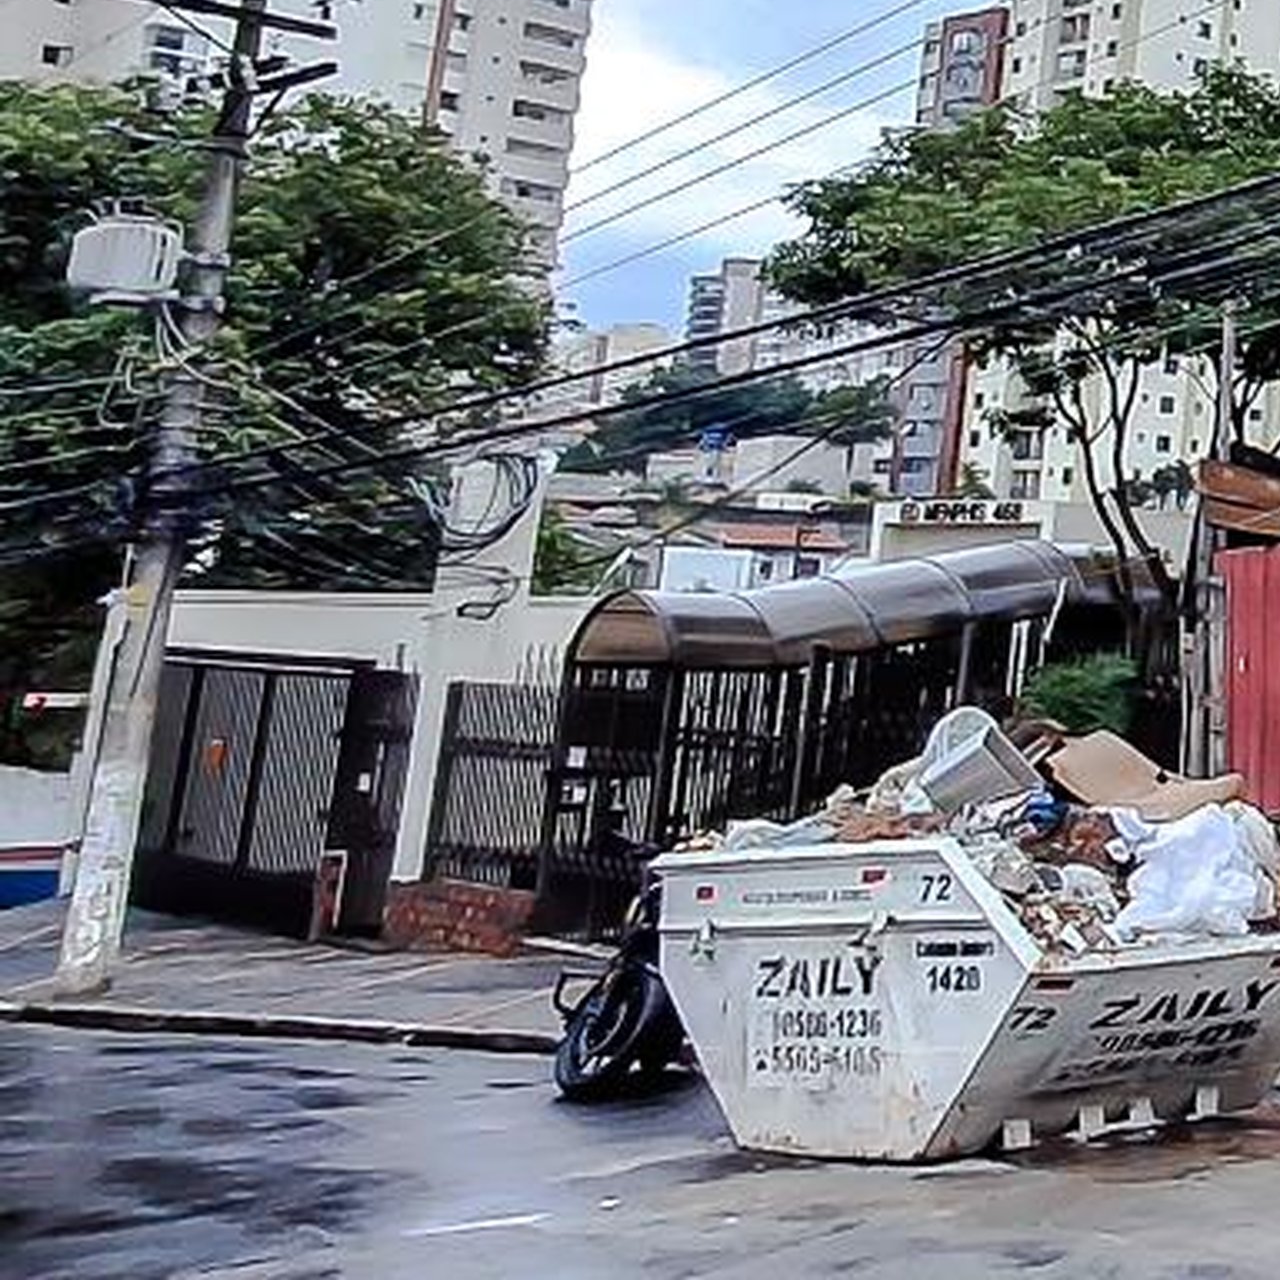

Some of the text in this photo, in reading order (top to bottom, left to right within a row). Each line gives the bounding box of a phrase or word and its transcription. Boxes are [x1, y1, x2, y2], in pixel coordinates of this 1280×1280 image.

[922, 874, 951, 902] 72
[756, 956, 883, 998] ZAILY
[1010, 1006, 1056, 1031] 72
[1090, 980, 1280, 1029] ZAILY
